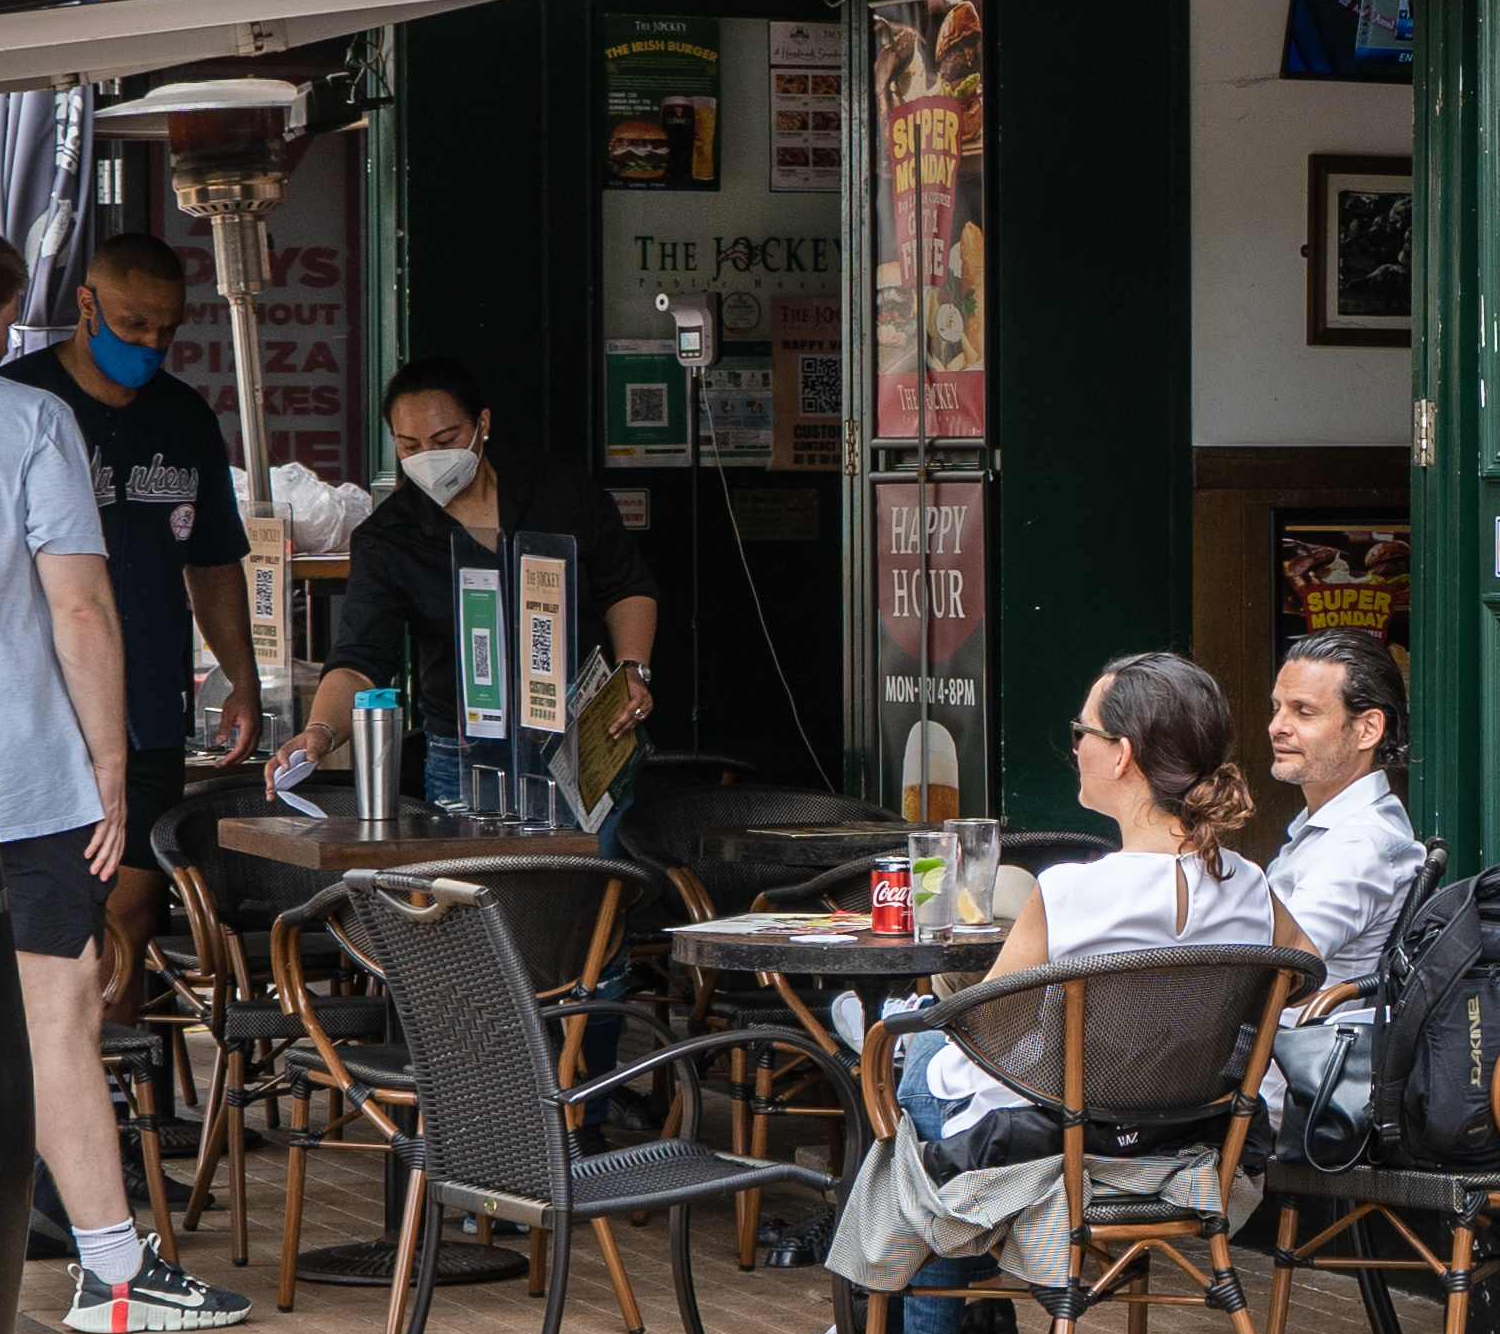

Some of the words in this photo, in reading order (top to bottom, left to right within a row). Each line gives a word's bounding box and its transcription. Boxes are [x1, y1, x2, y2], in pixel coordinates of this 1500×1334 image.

[653, 22, 687, 33] JOCKEY
[605, 44, 629, 59] THE
[632, 41, 665, 53] IRISH
[668, 41, 718, 62] BURGER
[634, 236, 697, 272] THE
[890, 505, 967, 555] HAPPY
[892, 569, 965, 619] HOUR
[1307, 588, 1392, 612] SUPER
[1311, 610, 1389, 630] MONDAY
[937, 678, 975, 706] 4-8PM
